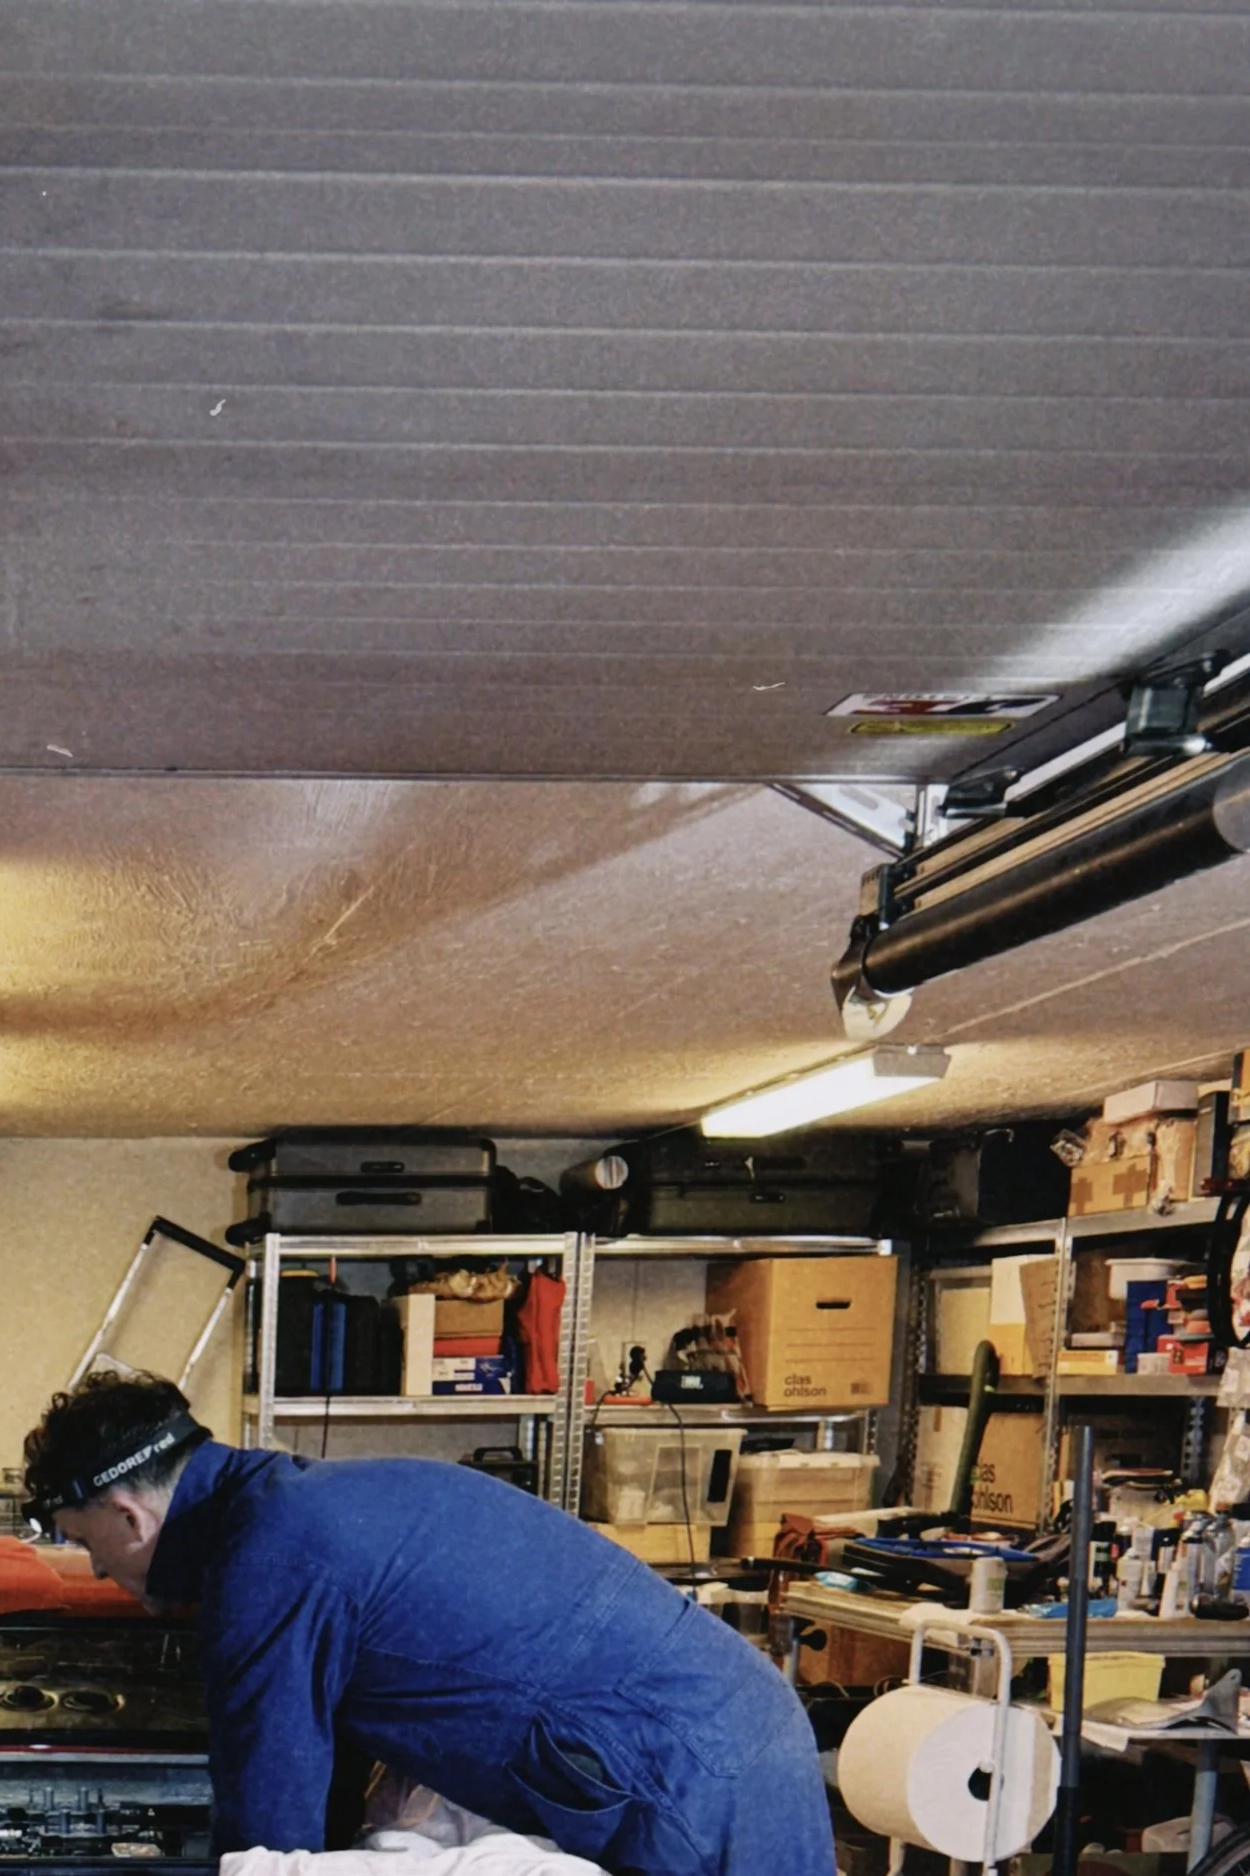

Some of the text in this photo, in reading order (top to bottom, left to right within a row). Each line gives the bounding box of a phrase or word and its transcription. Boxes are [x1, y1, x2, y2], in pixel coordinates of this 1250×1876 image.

[784, 1373, 812, 1386] clas
[783, 1385, 827, 1397] ohlson
[93, 1449, 148, 1487] GEDORE
